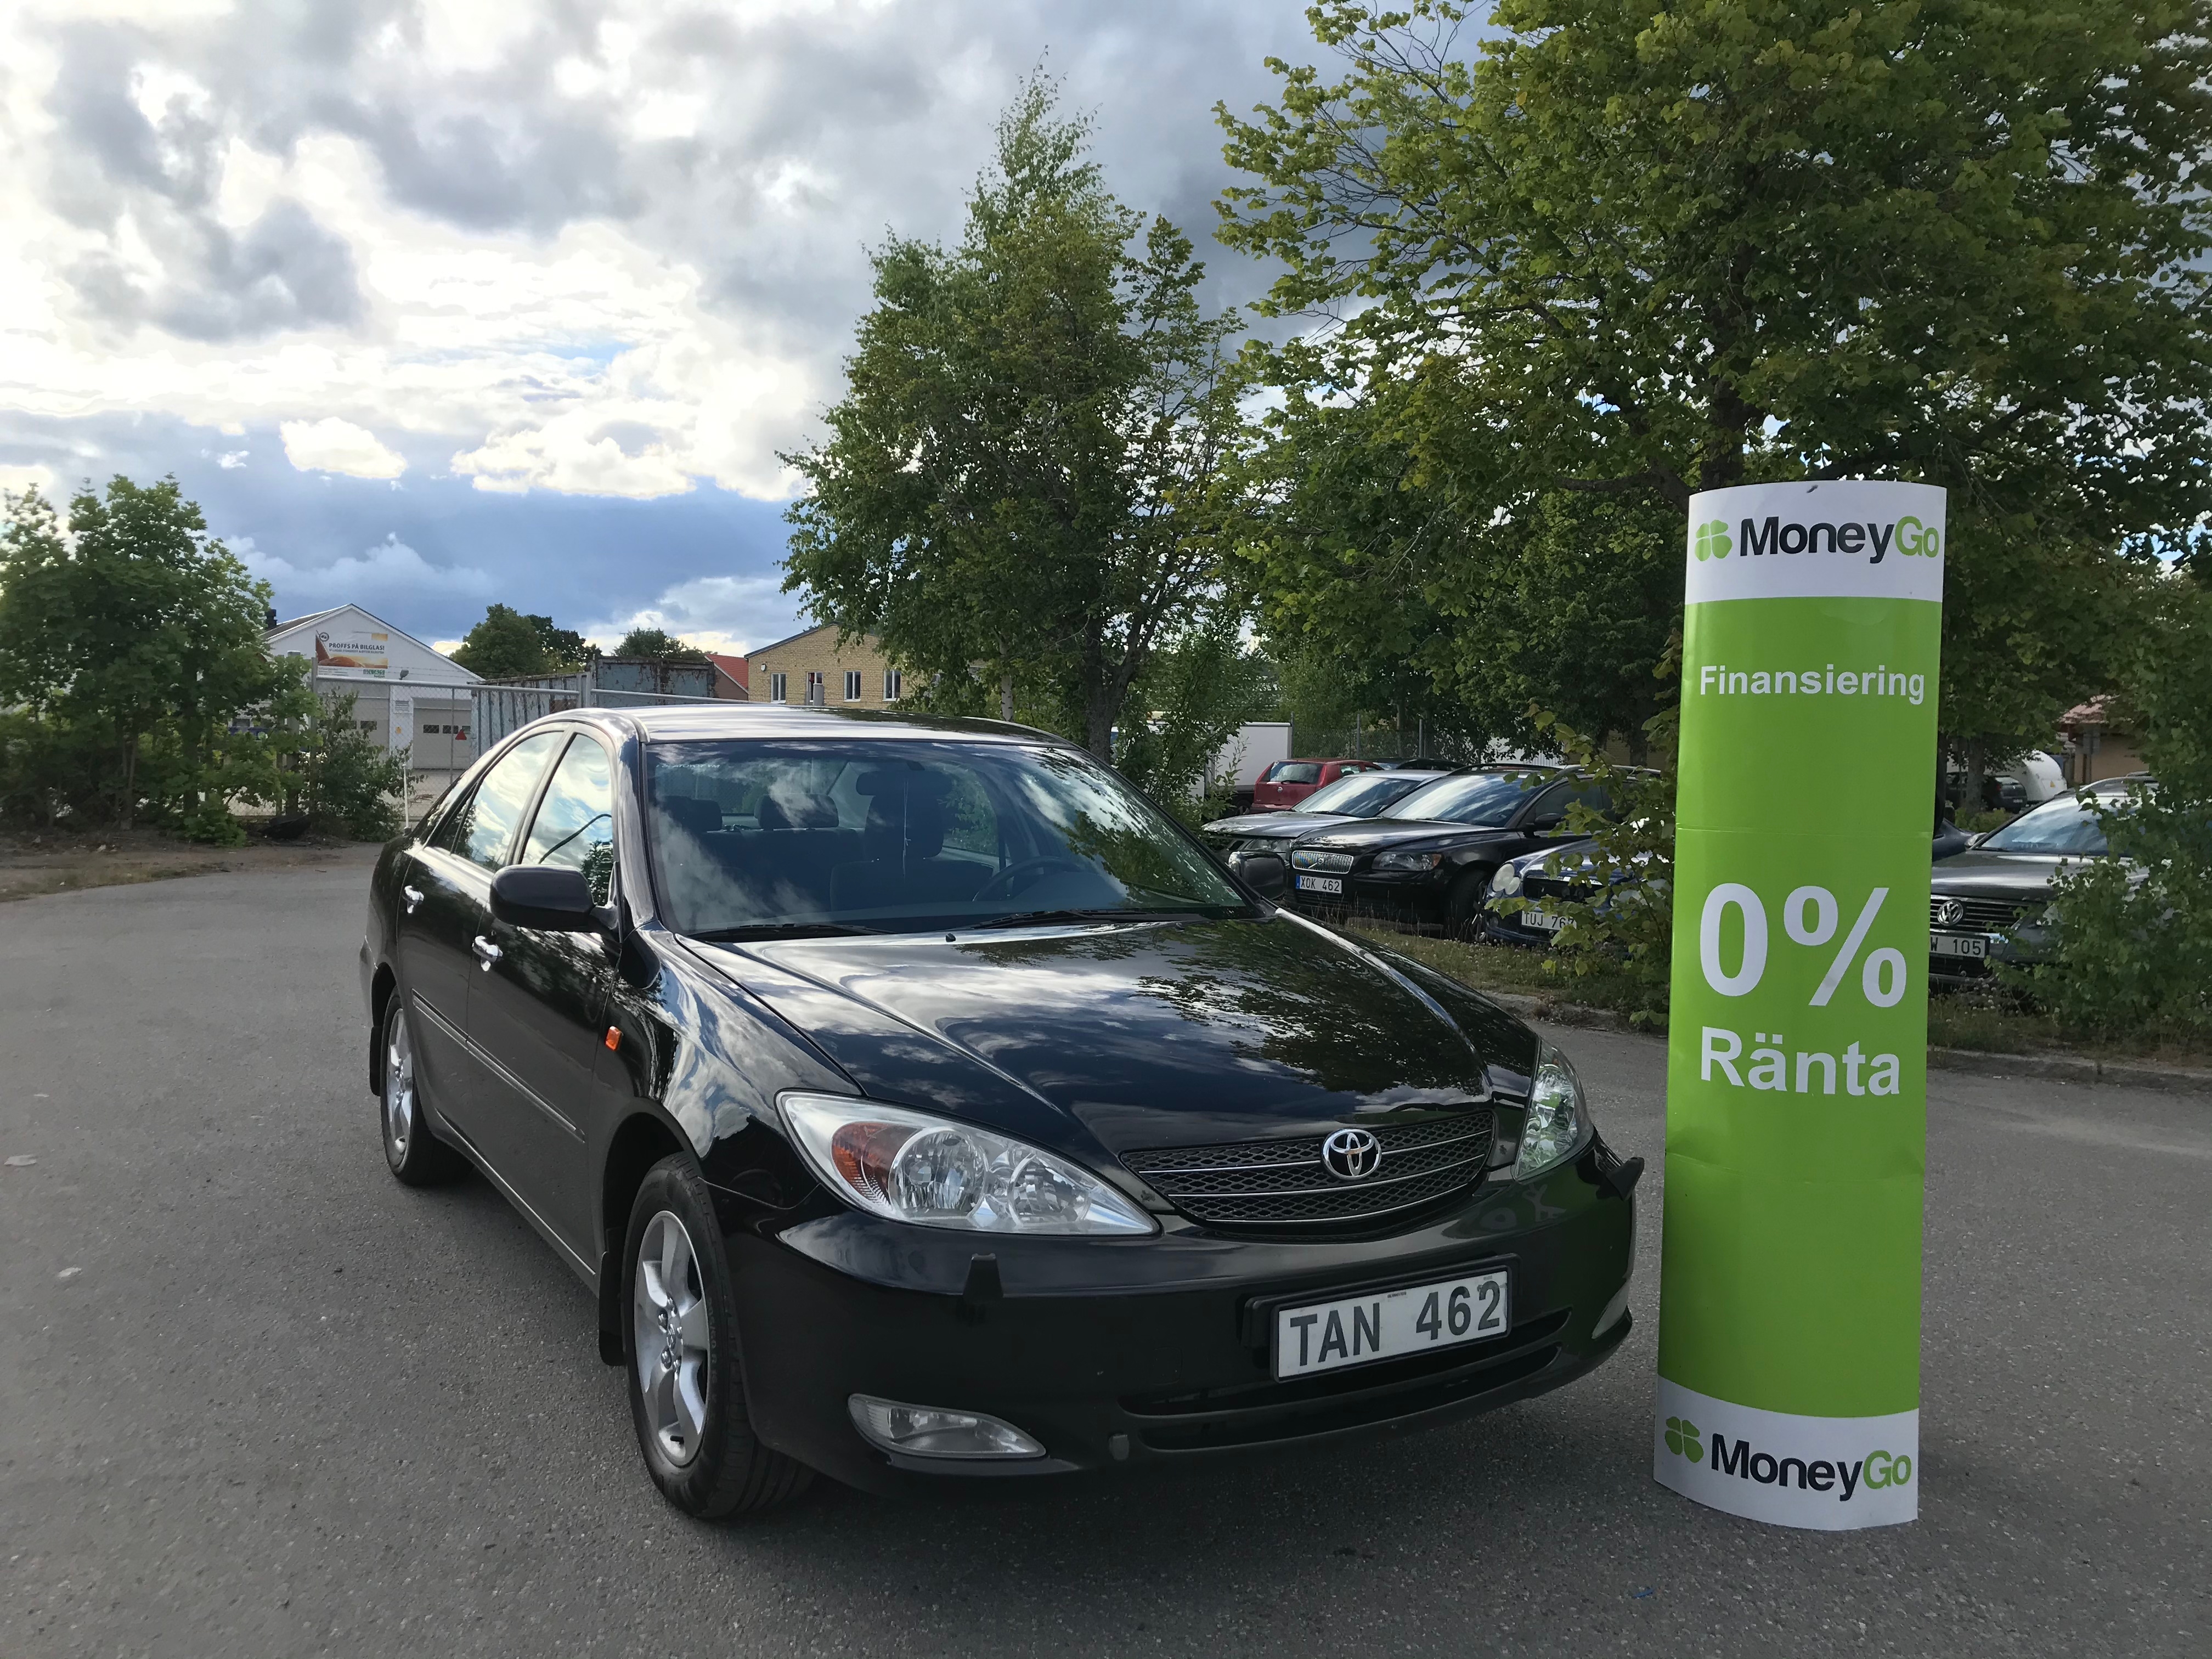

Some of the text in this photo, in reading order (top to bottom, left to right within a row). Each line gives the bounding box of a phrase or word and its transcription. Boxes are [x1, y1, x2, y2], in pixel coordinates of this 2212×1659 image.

[1740, 516, 1939, 563] MoneyGo
[1701, 664, 1925, 705] Finansiering
[1301, 877, 1339, 892] XOK 462
[1525, 912, 1543, 926] TUJ
[1700, 883, 1907, 1007] 0%
[1953, 939, 1981, 956] 105
[1701, 1026, 1900, 1096] Ränta
[1290, 1280, 1500, 1367] TAN 462
[1711, 1433, 1912, 1502] MoneyGo
